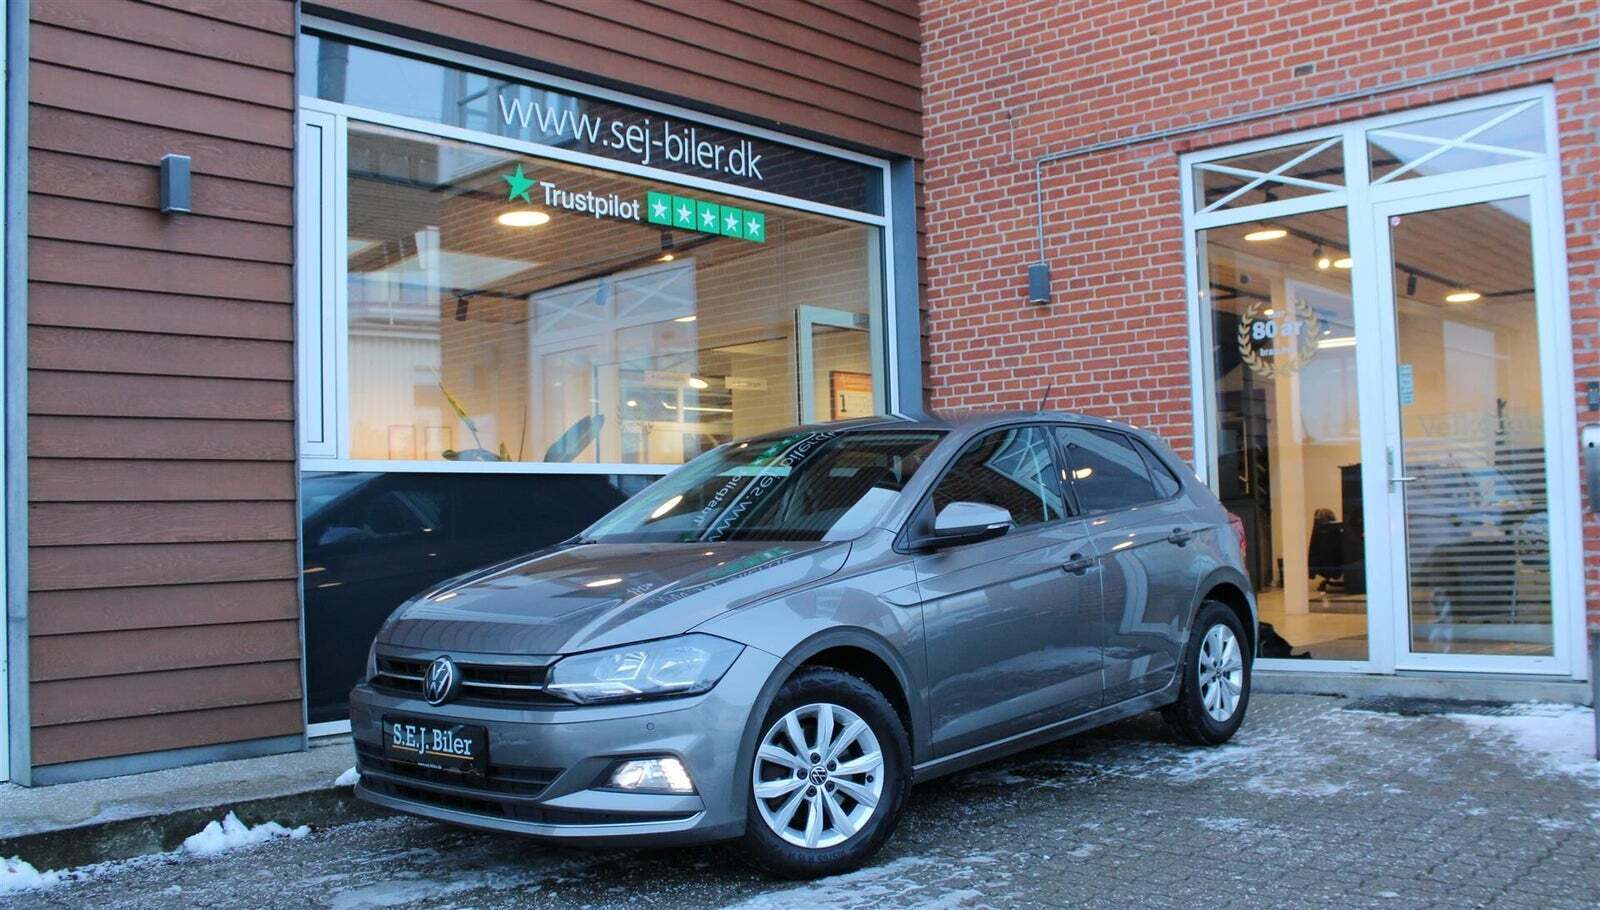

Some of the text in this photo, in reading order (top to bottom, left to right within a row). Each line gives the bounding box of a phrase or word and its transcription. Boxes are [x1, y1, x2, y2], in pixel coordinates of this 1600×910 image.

[499, 94, 764, 180] www.sej-biler.dk
[539, 181, 641, 221] Trustpilot
[1252, 321, 1277, 340] 80
[393, 723, 472, 756] S.E.J. Biler
